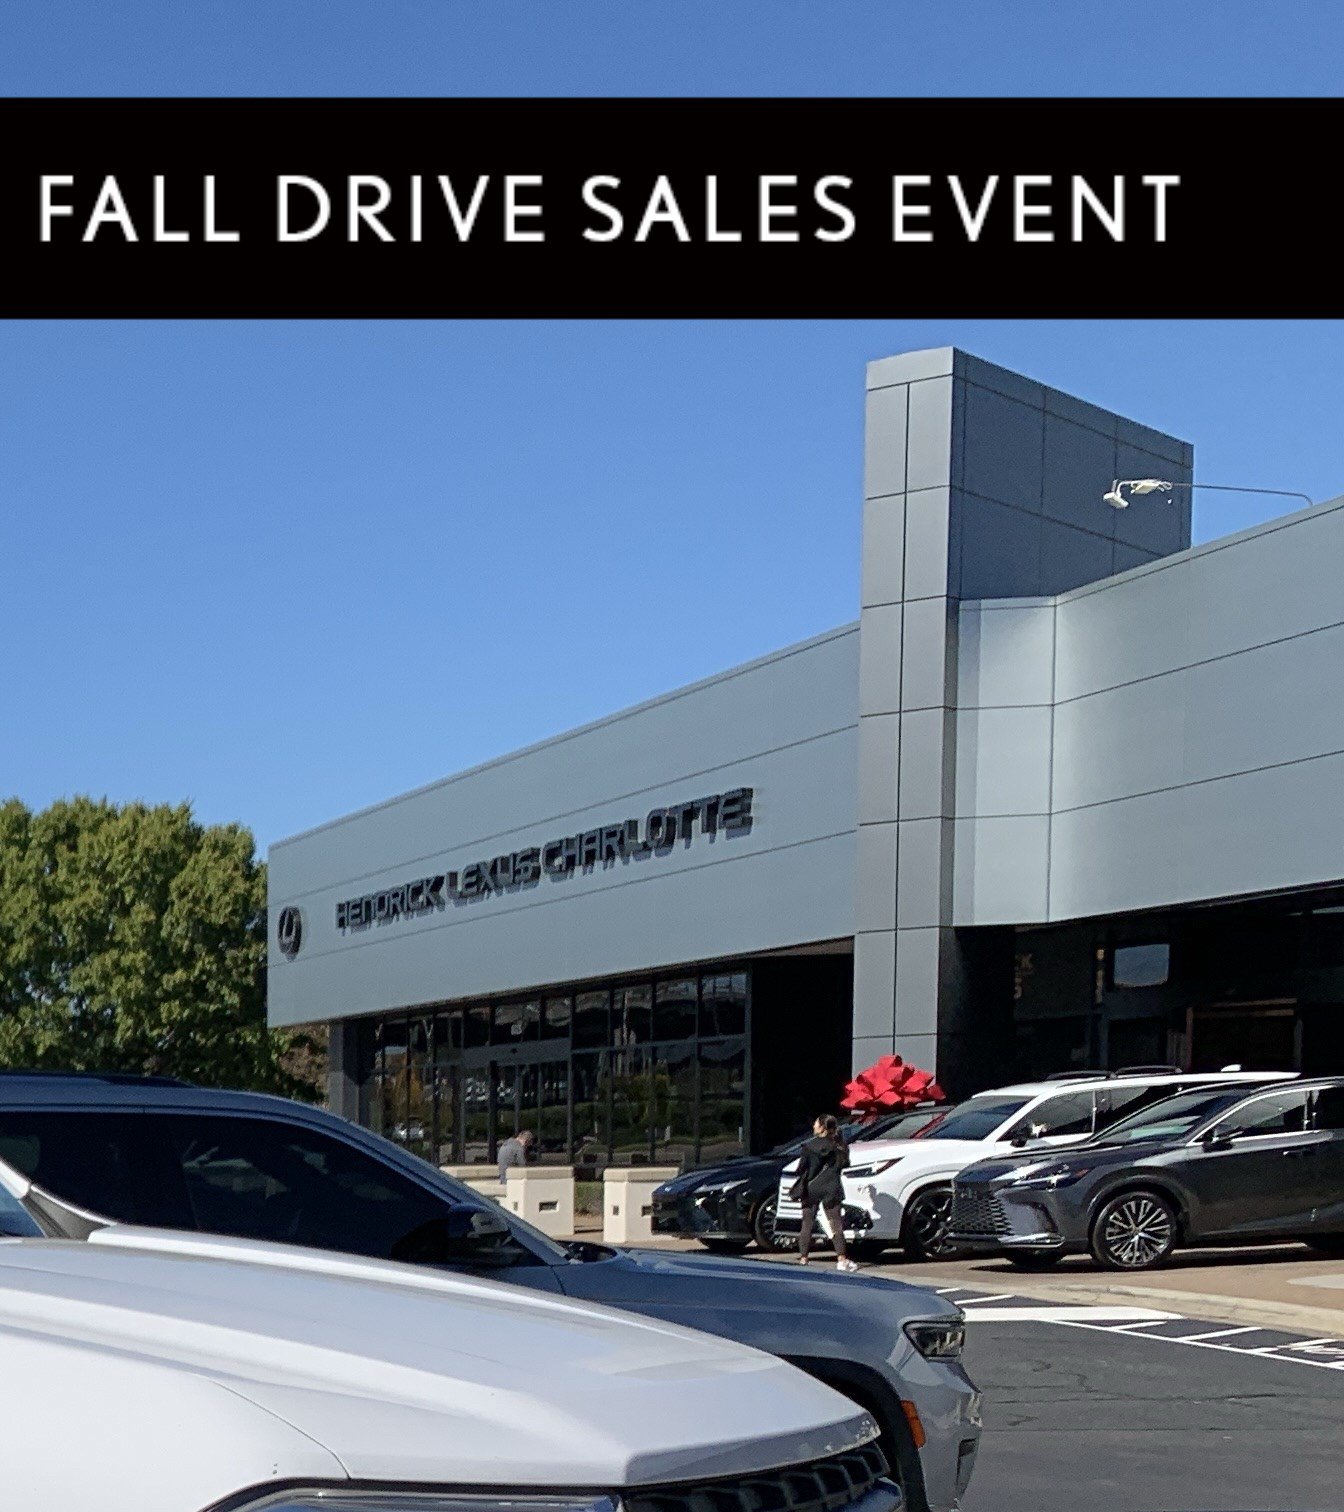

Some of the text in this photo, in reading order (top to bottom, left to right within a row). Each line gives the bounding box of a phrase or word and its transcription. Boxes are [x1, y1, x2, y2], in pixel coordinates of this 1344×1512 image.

[336, 788, 755, 931] HENDRICK LEXUS CHARLOTTE
